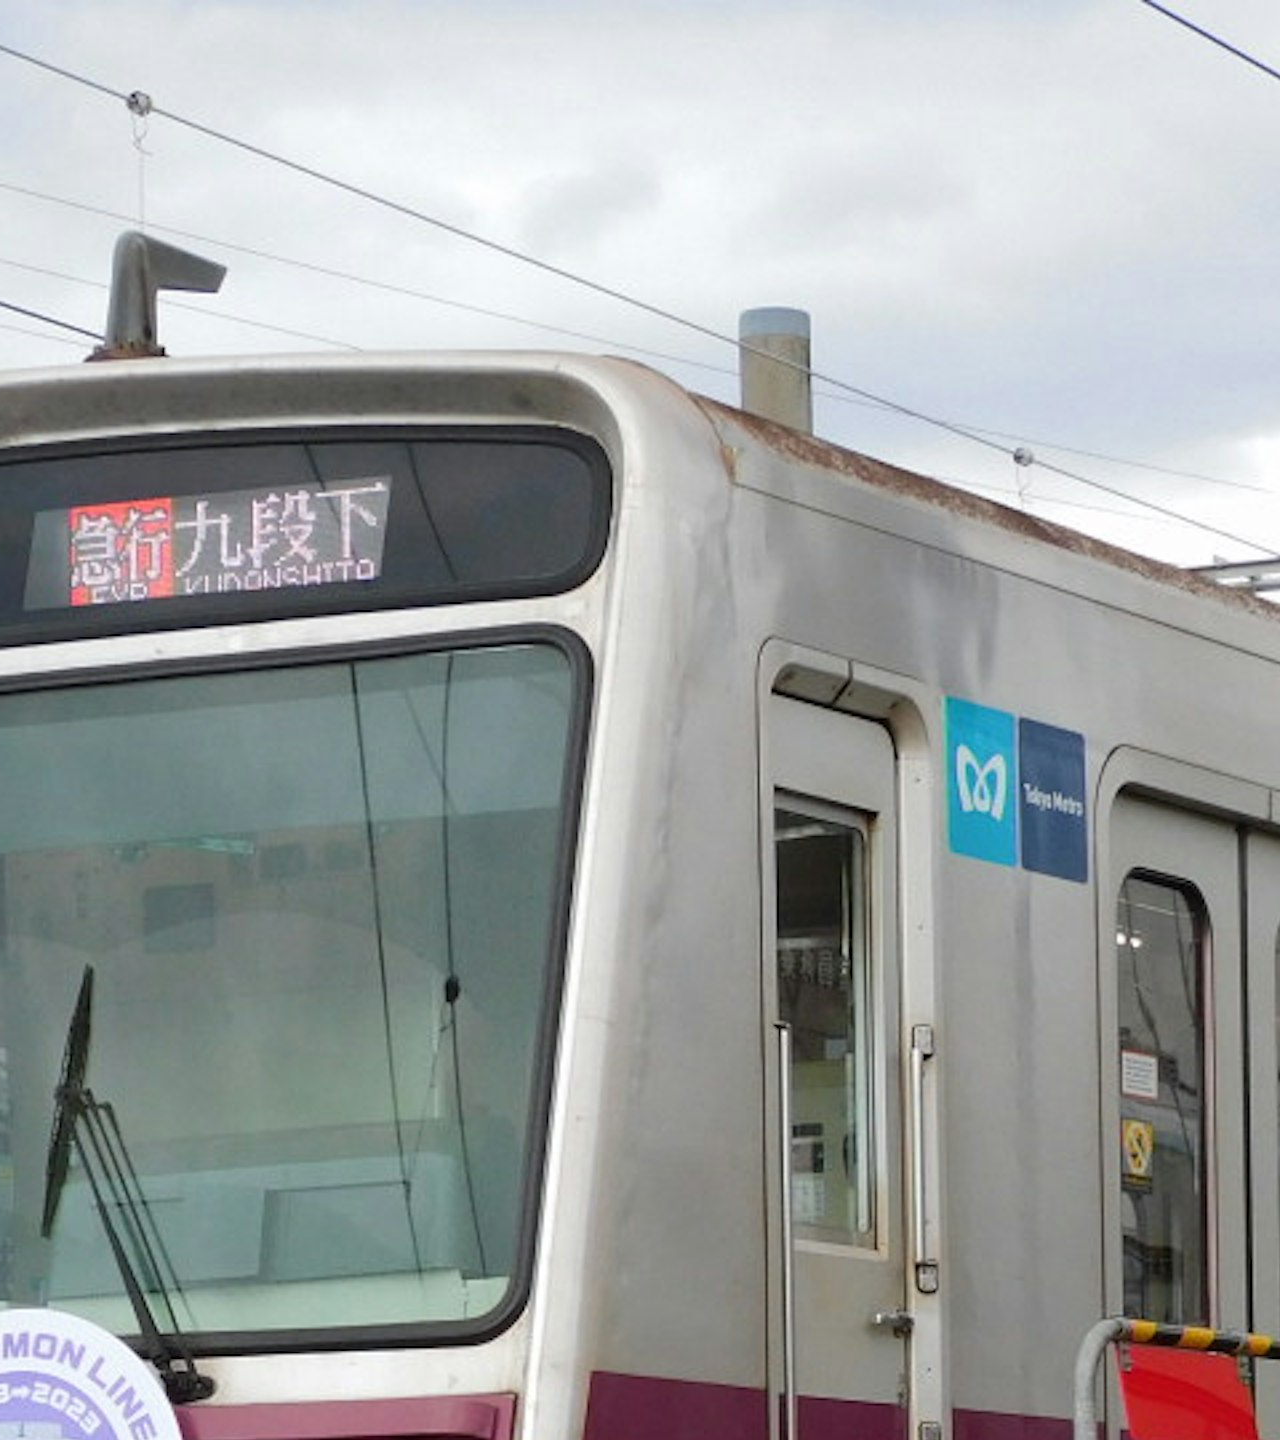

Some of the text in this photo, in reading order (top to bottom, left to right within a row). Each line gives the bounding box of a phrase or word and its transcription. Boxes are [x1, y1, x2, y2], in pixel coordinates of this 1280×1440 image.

[71, 482, 386, 588] 急行 九段下
[1023, 783, 1083, 817] Tokyo Metro
[31, 1381, 102, 1434] 2023
